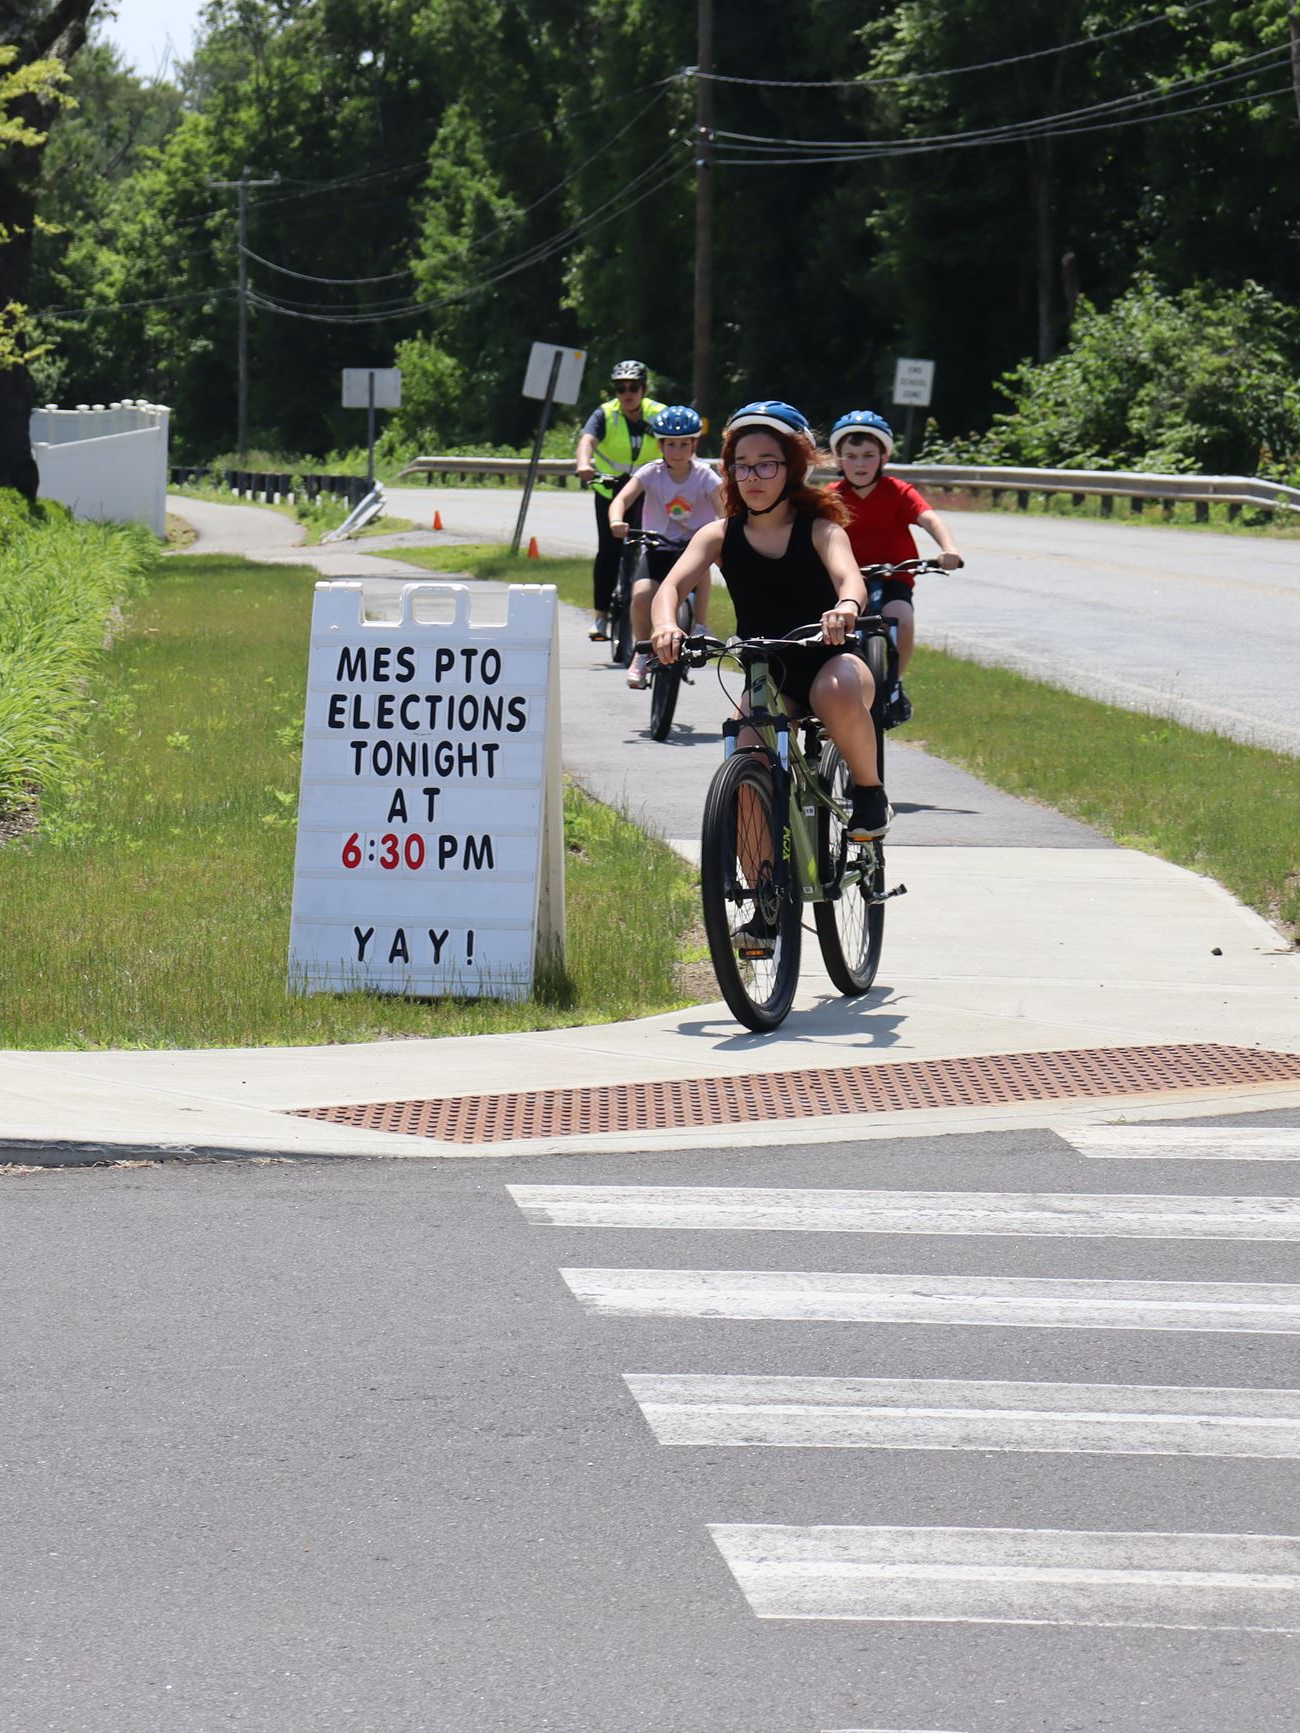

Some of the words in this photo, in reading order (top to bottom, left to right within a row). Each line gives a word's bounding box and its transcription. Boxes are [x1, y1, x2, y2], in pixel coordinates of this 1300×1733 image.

[336, 646, 416, 683] MES
[435, 647, 501, 685] PTO
[328, 693, 527, 733] ELECTIONS
[350, 740, 500, 778] TONIGHT
[387, 787, 441, 823] AT
[342, 832, 426, 869] 6:30
[438, 834, 495, 871] PM
[354, 926, 476, 966] YAY!
